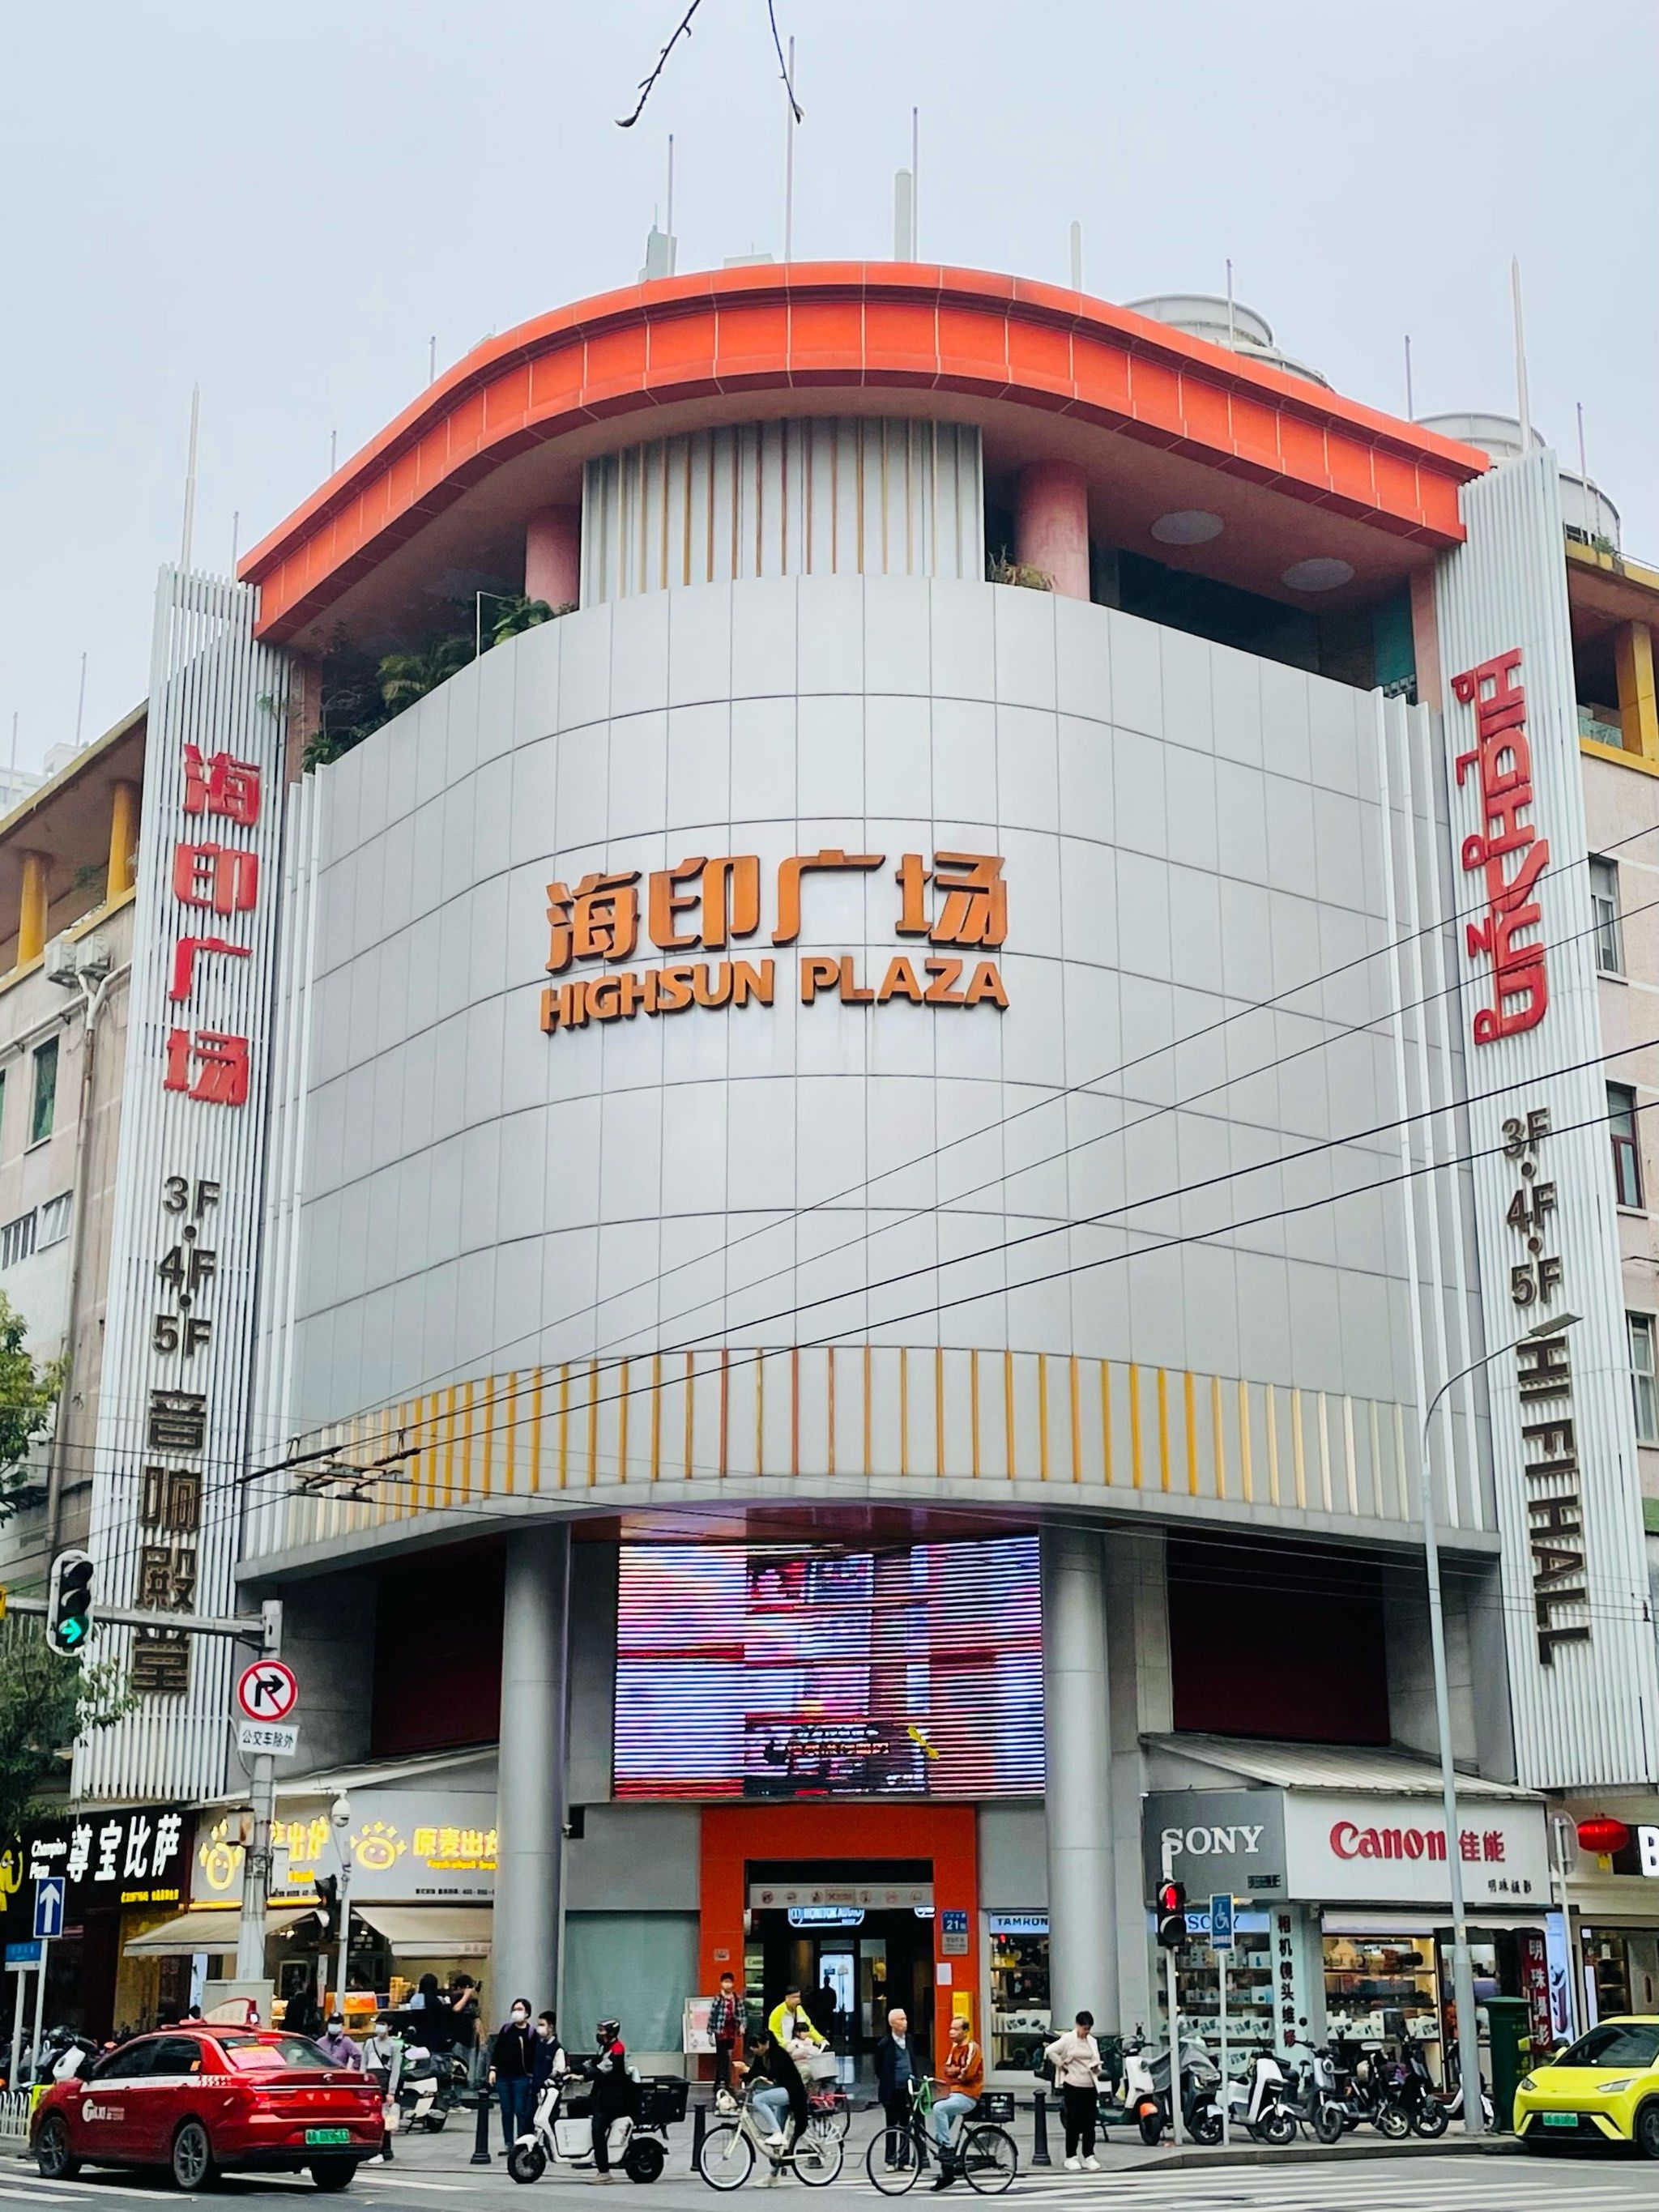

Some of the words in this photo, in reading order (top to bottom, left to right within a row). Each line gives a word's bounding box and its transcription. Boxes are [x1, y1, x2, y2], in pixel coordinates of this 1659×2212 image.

[1452, 668, 1497, 1046] PLAZA
[1477, 648, 1549, 1038] HIGHSUN
[164, 744, 262, 1106] 海印广场
[546, 850, 1009, 972] 海印广场
[539, 959, 774, 1034] HIGHSUN
[800, 956, 1009, 1010] PLAZA
[1502, 1107, 1550, 1158] 3F
[163, 1176, 220, 1217] 3F
[1507, 1181, 1557, 1233] 4F
[158, 1246, 216, 1292] 4F
[1511, 1256, 1562, 1306] 5F
[153, 1314, 212, 1357] 5F
[131, 1389, 207, 1693] 音响殿堂
[1528, 1495, 1591, 1666] HALL
[243, 1729, 293, 1750] 公交车除外
[66, 1813, 181, 1882] 尊宝比萨
[1162, 1825, 1265, 1856] SONY
[1329, 1821, 1447, 1860] Canon
[1459, 1829, 1505, 1862] 佳能
[1488, 1878, 1533, 1894] 明珠摄影
[998, 1917, 1048, 1926] TAMRON
[1188, 1915, 1239, 1930] SOY
[1277, 1915, 1295, 2048] 相机镜头维修
